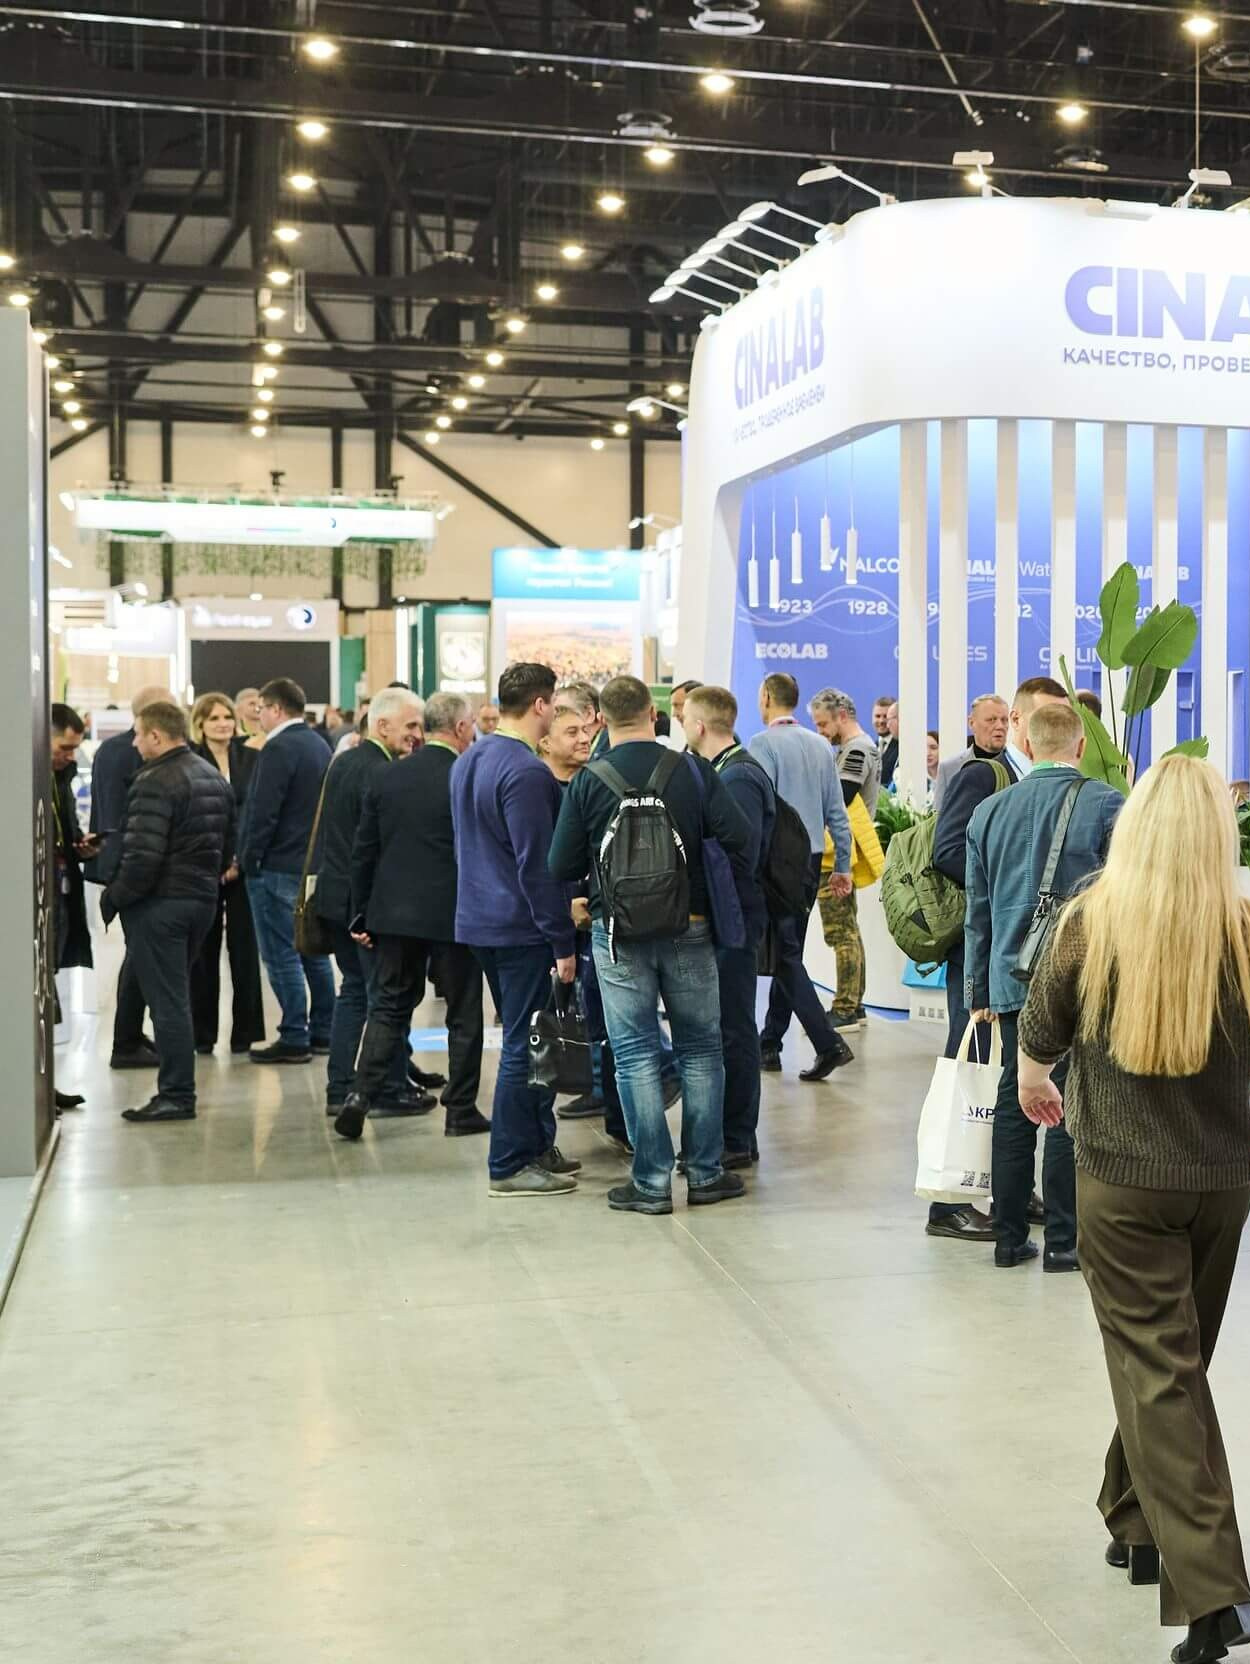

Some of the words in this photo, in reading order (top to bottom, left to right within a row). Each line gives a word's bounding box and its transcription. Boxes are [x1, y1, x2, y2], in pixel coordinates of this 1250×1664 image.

[734, 285, 825, 411] CINALAB
[1063, 347, 1177, 372] КАЧЕСТВО,
[848, 600, 889, 615] 1928
[755, 642, 829, 660] ECOLAB
